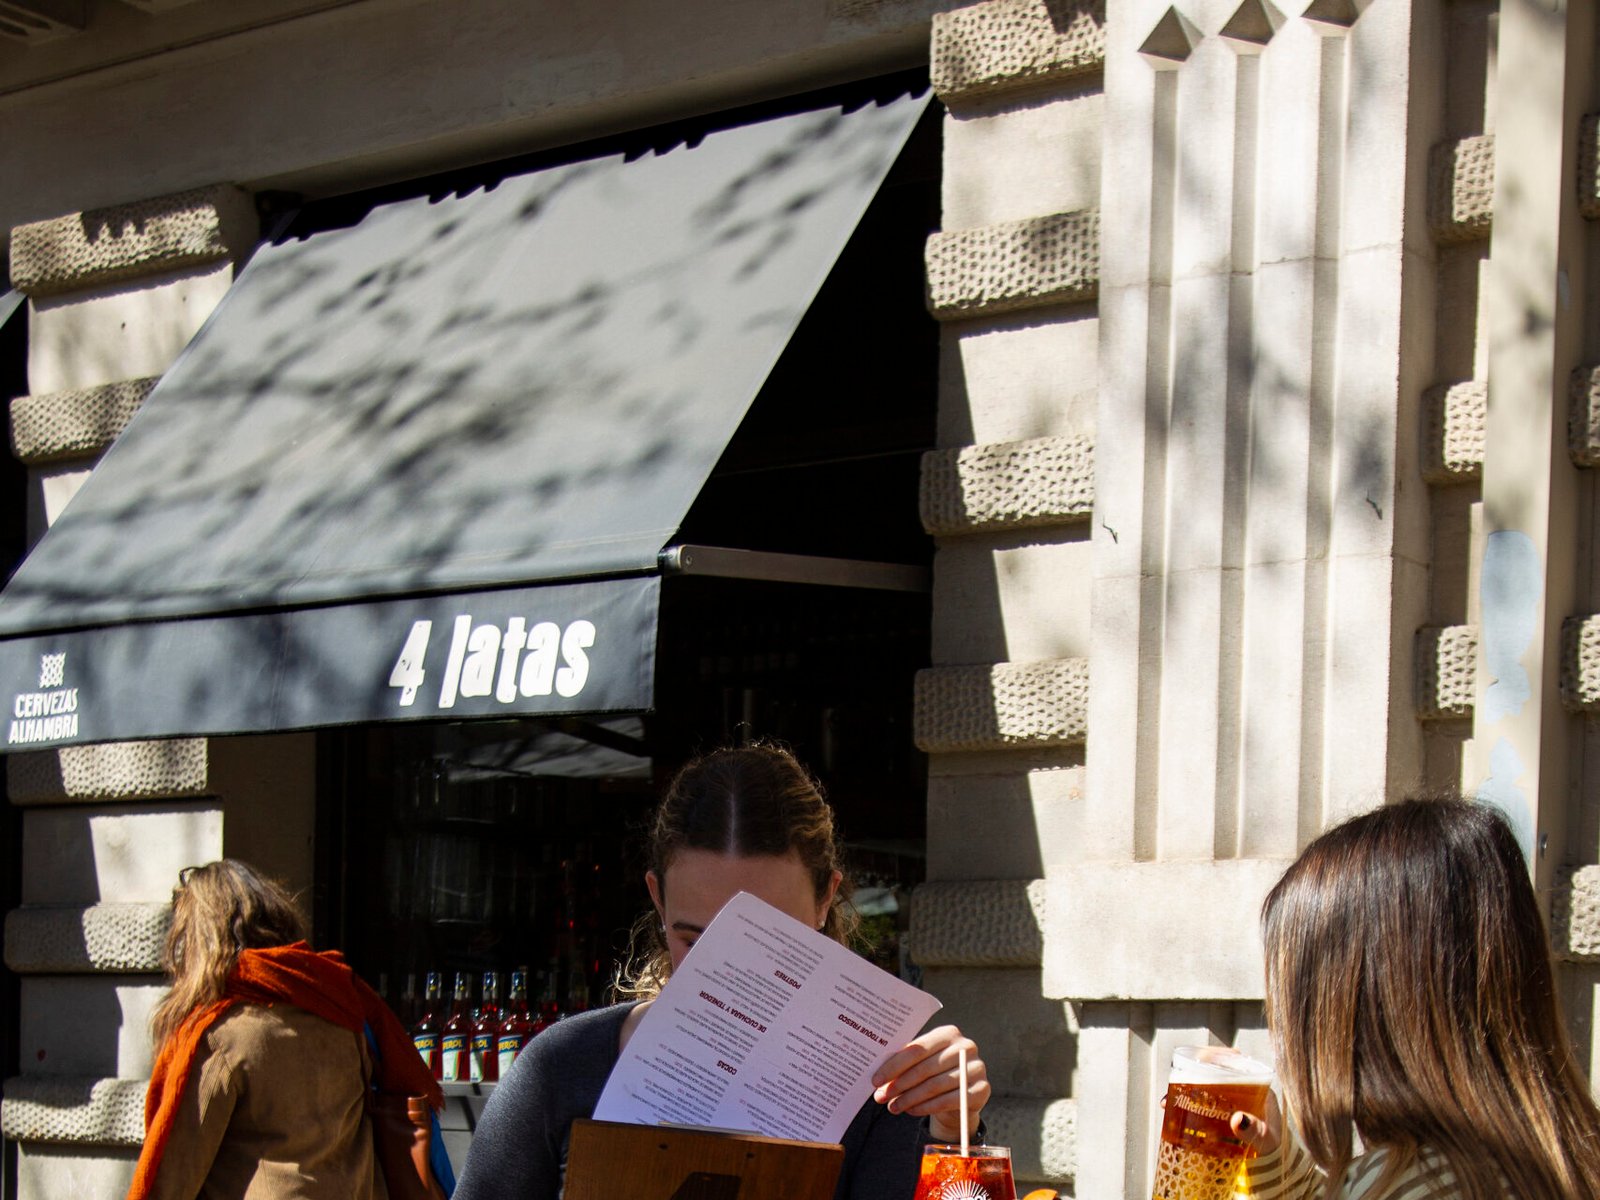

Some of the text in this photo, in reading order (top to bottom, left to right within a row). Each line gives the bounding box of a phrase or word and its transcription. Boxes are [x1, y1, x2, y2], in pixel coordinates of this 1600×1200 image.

[389, 614, 596, 709] 4 latas
[15, 688, 78, 718] CERVEZAS
[8, 713, 79, 744] ALHAMBRA
[774, 970, 801, 989] POSTRES
[699, 991, 726, 1009] TENEDOR
[731, 1008, 759, 1028] CUCHARA
[838, 1014, 861, 1030] FRESCO
[757, 1024, 768, 1033] DE
[859, 1027, 879, 1041] TOQUE
[878, 1038, 888, 1046] UN
[717, 1060, 737, 1075] COCAS
[1173, 1094, 1231, 1121] Alhambra
